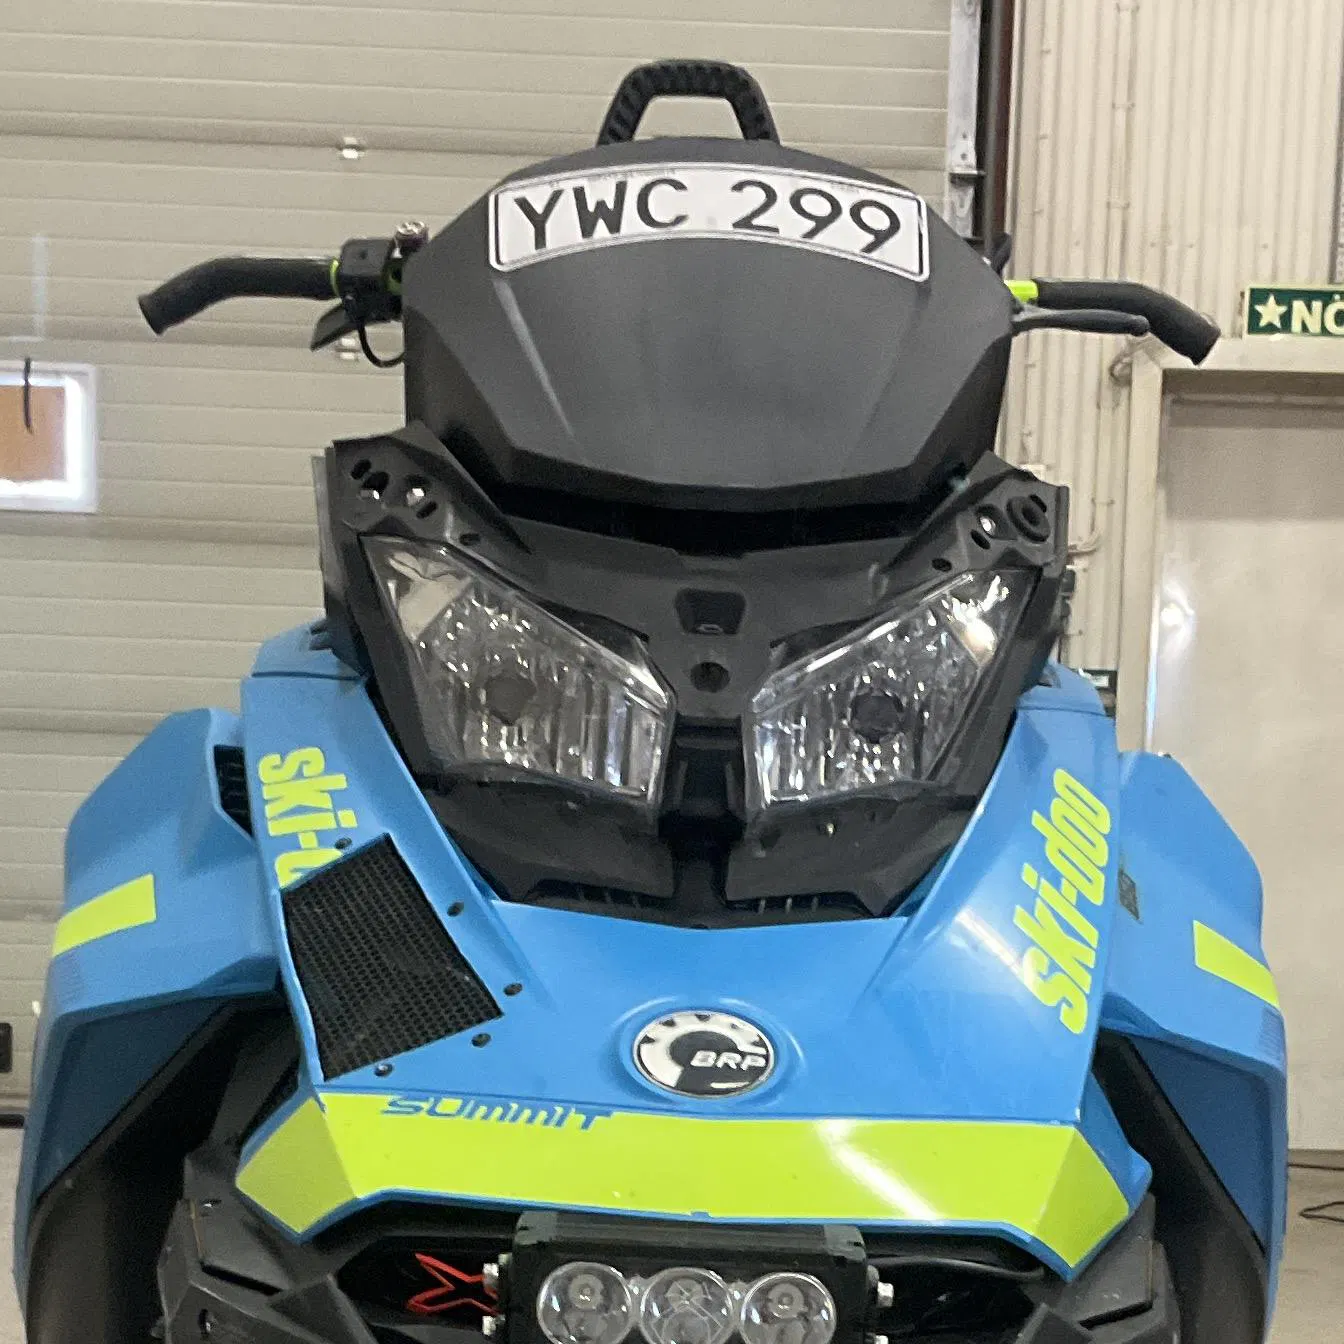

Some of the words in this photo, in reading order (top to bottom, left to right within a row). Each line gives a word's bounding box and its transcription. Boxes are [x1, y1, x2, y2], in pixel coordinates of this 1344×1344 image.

[514, 178, 690, 250] YWC
[730, 180, 901, 254] 299
[1012, 768, 1111, 1034] ski-doo
[690, 1050, 766, 1071] BRP
